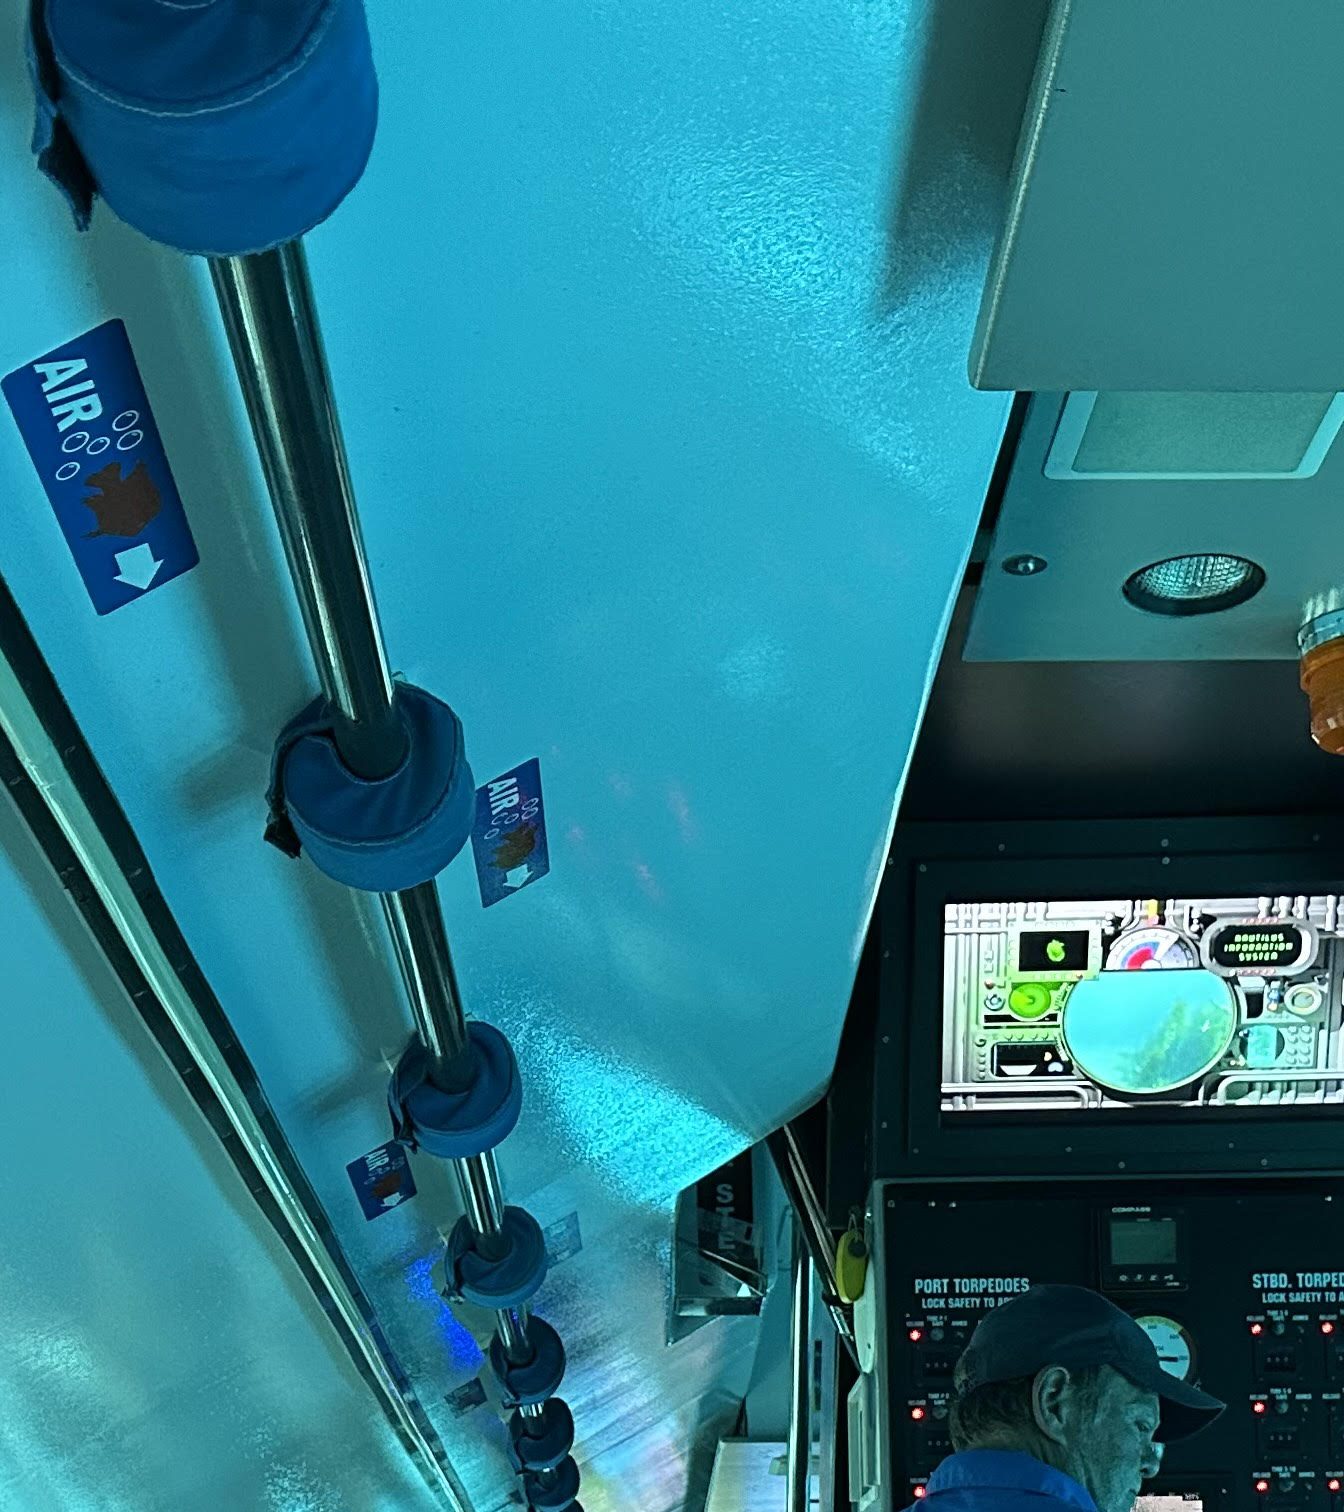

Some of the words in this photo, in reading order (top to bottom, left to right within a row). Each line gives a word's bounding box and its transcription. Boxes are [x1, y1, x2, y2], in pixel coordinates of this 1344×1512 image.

[33, 357, 104, 433] AIR
[488, 775, 518, 816] AIR
[364, 1148, 390, 1172] AIR
[914, 1278, 950, 1294] PORT
[952, 1277, 1031, 1294] TORPEDOES
[1252, 1272, 1293, 1289] STBD.
[921, 1298, 946, 1309] LOCK
[947, 1297, 981, 1309] SAFETY
[983, 1297, 995, 1308] TO
[1261, 1291, 1287, 1304] LOCK
[1288, 1291, 1322, 1303] SAFETY
[1324, 1291, 1337, 1303] TO
